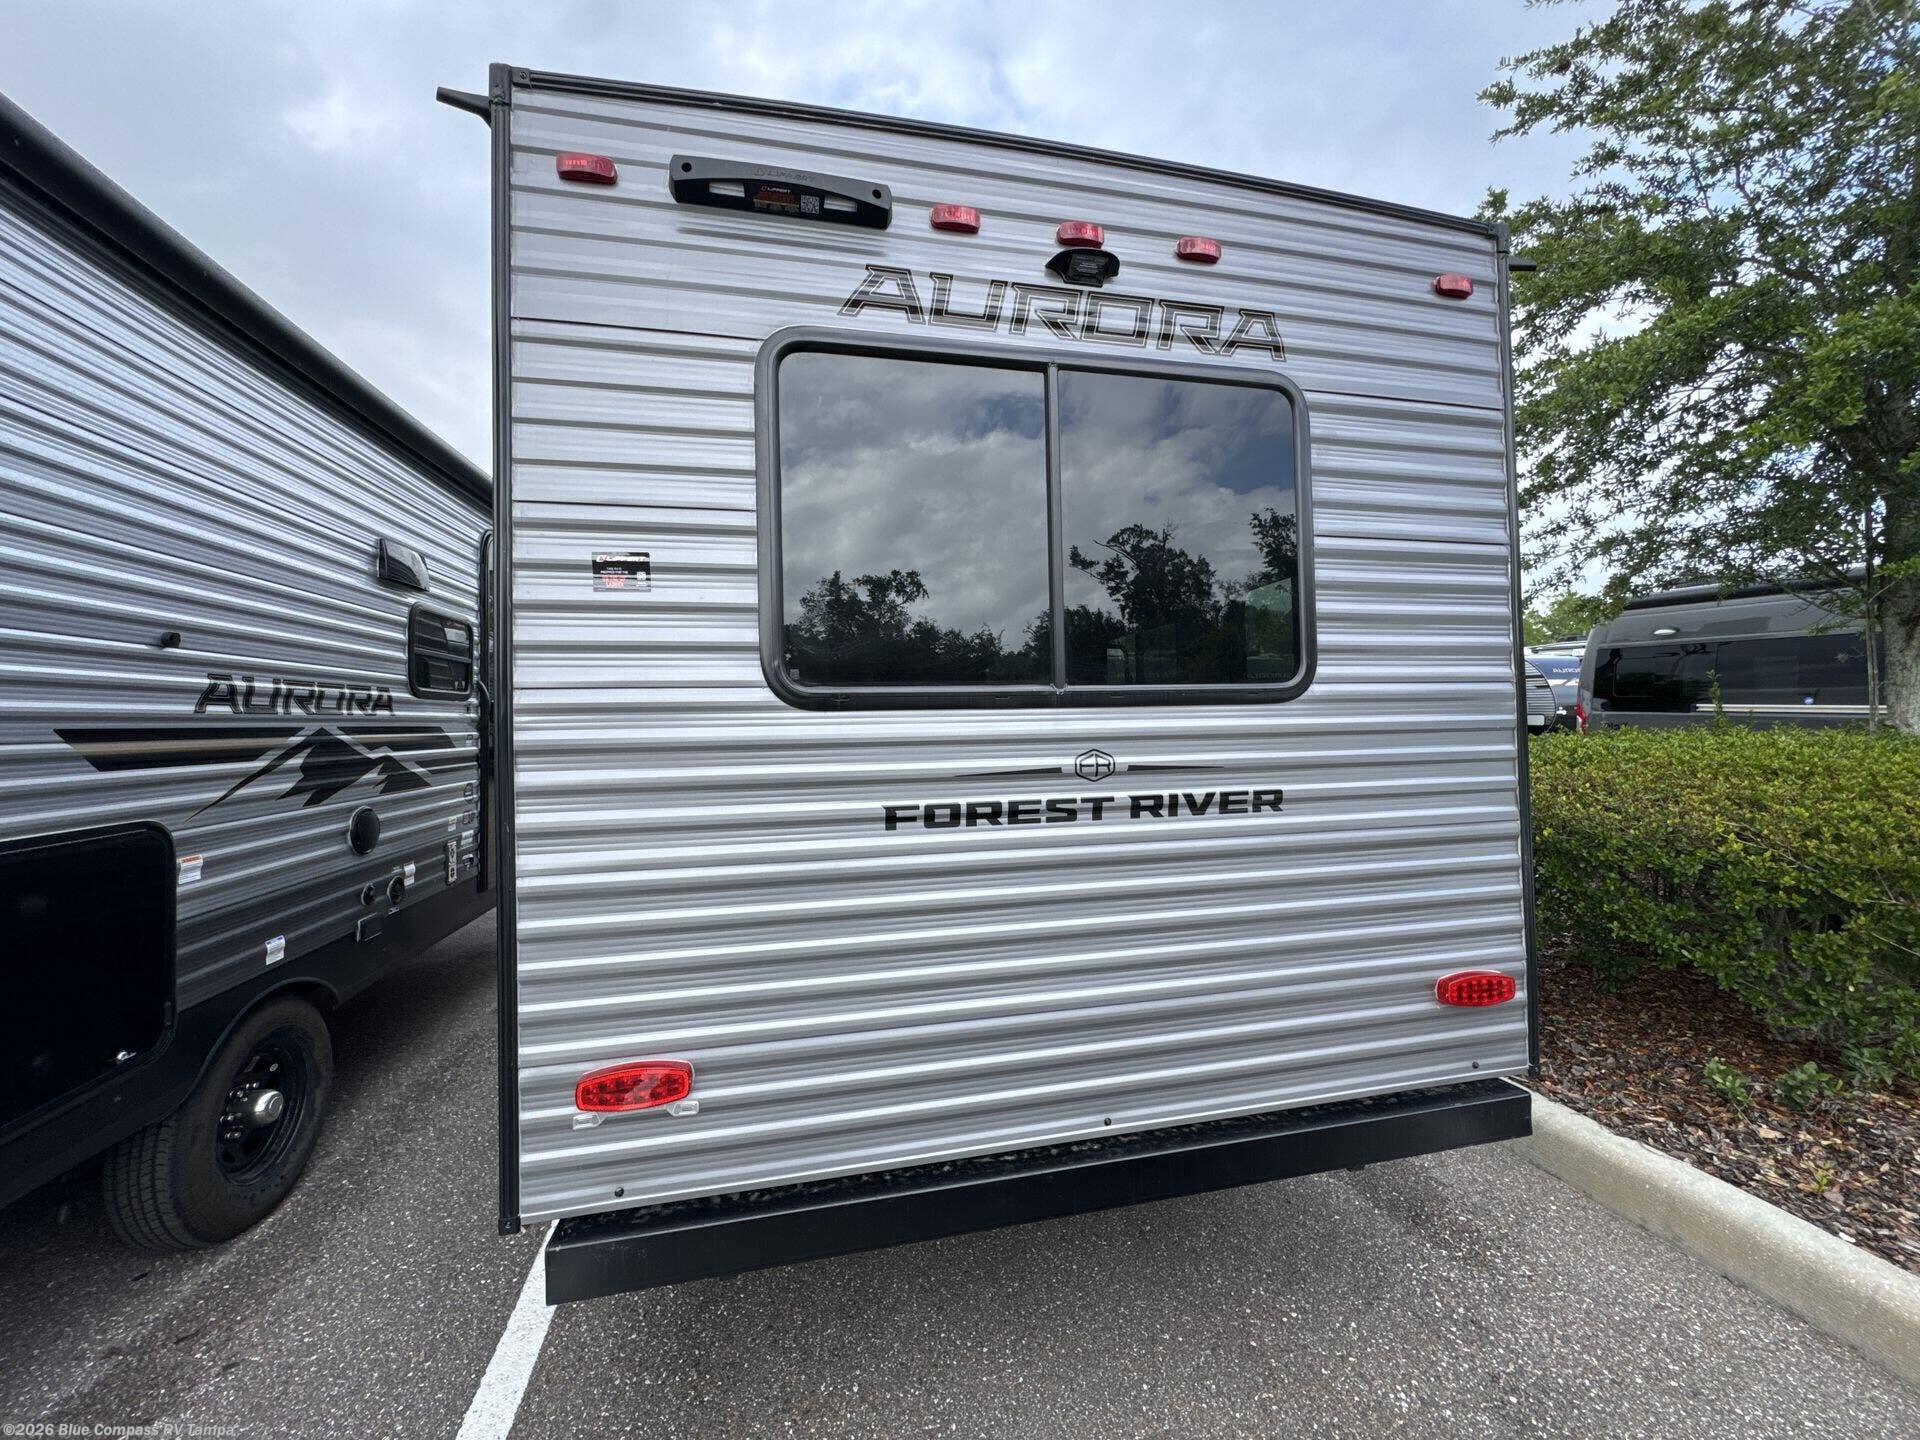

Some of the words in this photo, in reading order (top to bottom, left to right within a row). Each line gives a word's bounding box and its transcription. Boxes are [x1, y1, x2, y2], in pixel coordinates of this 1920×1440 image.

[837, 264, 1287, 362] AURORA
[194, 673, 395, 716] AURORA
[881, 797, 1114, 831] FOREST
[1128, 789, 1283, 819] RIVER
